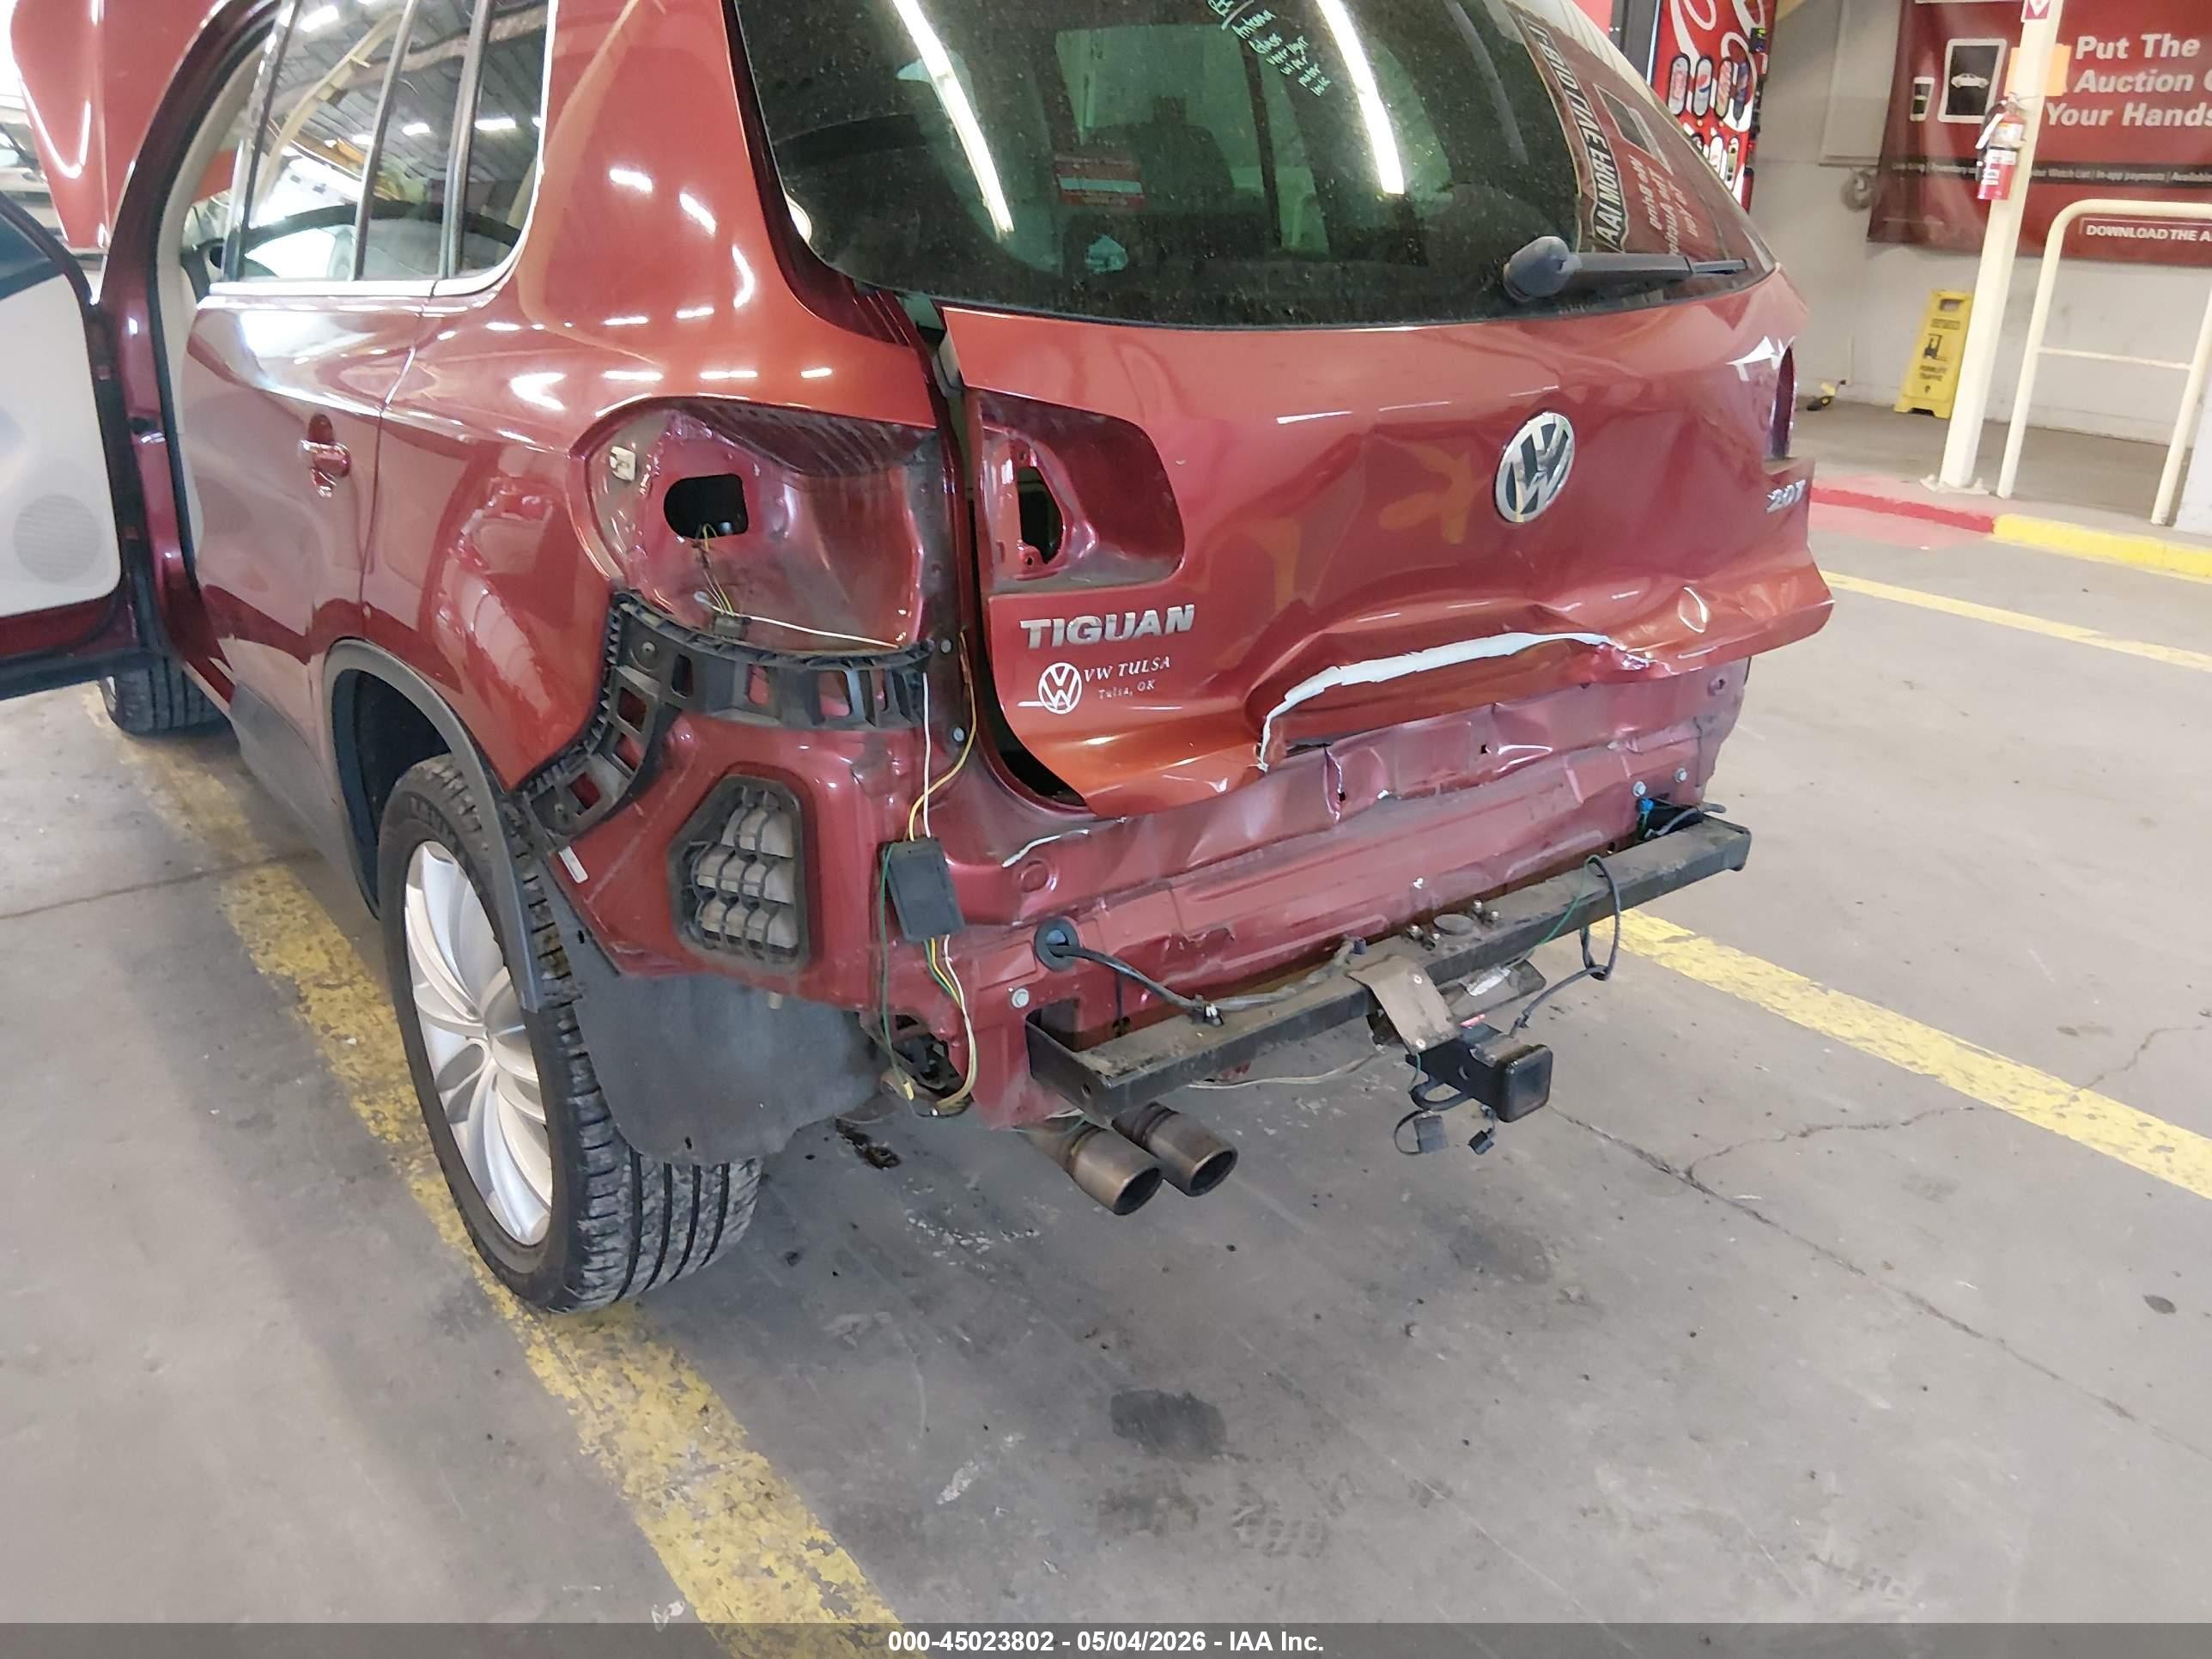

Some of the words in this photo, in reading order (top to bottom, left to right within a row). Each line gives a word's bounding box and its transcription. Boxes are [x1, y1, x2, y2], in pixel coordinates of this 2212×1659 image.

[2075, 35, 2130, 60] Put
[2140, 33, 2202, 58] The
[2073, 68, 2195, 94] Auction
[2045, 102, 2114, 126] Your
[2086, 224, 2168, 240] DOWNLOAD
[2169, 228, 2198, 241] THE
[1019, 604, 1195, 649] TIGUAN
[1084, 665, 1114, 683] VW
[1118, 655, 1171, 678] TULSA
[1137, 679, 1156, 692] OK
